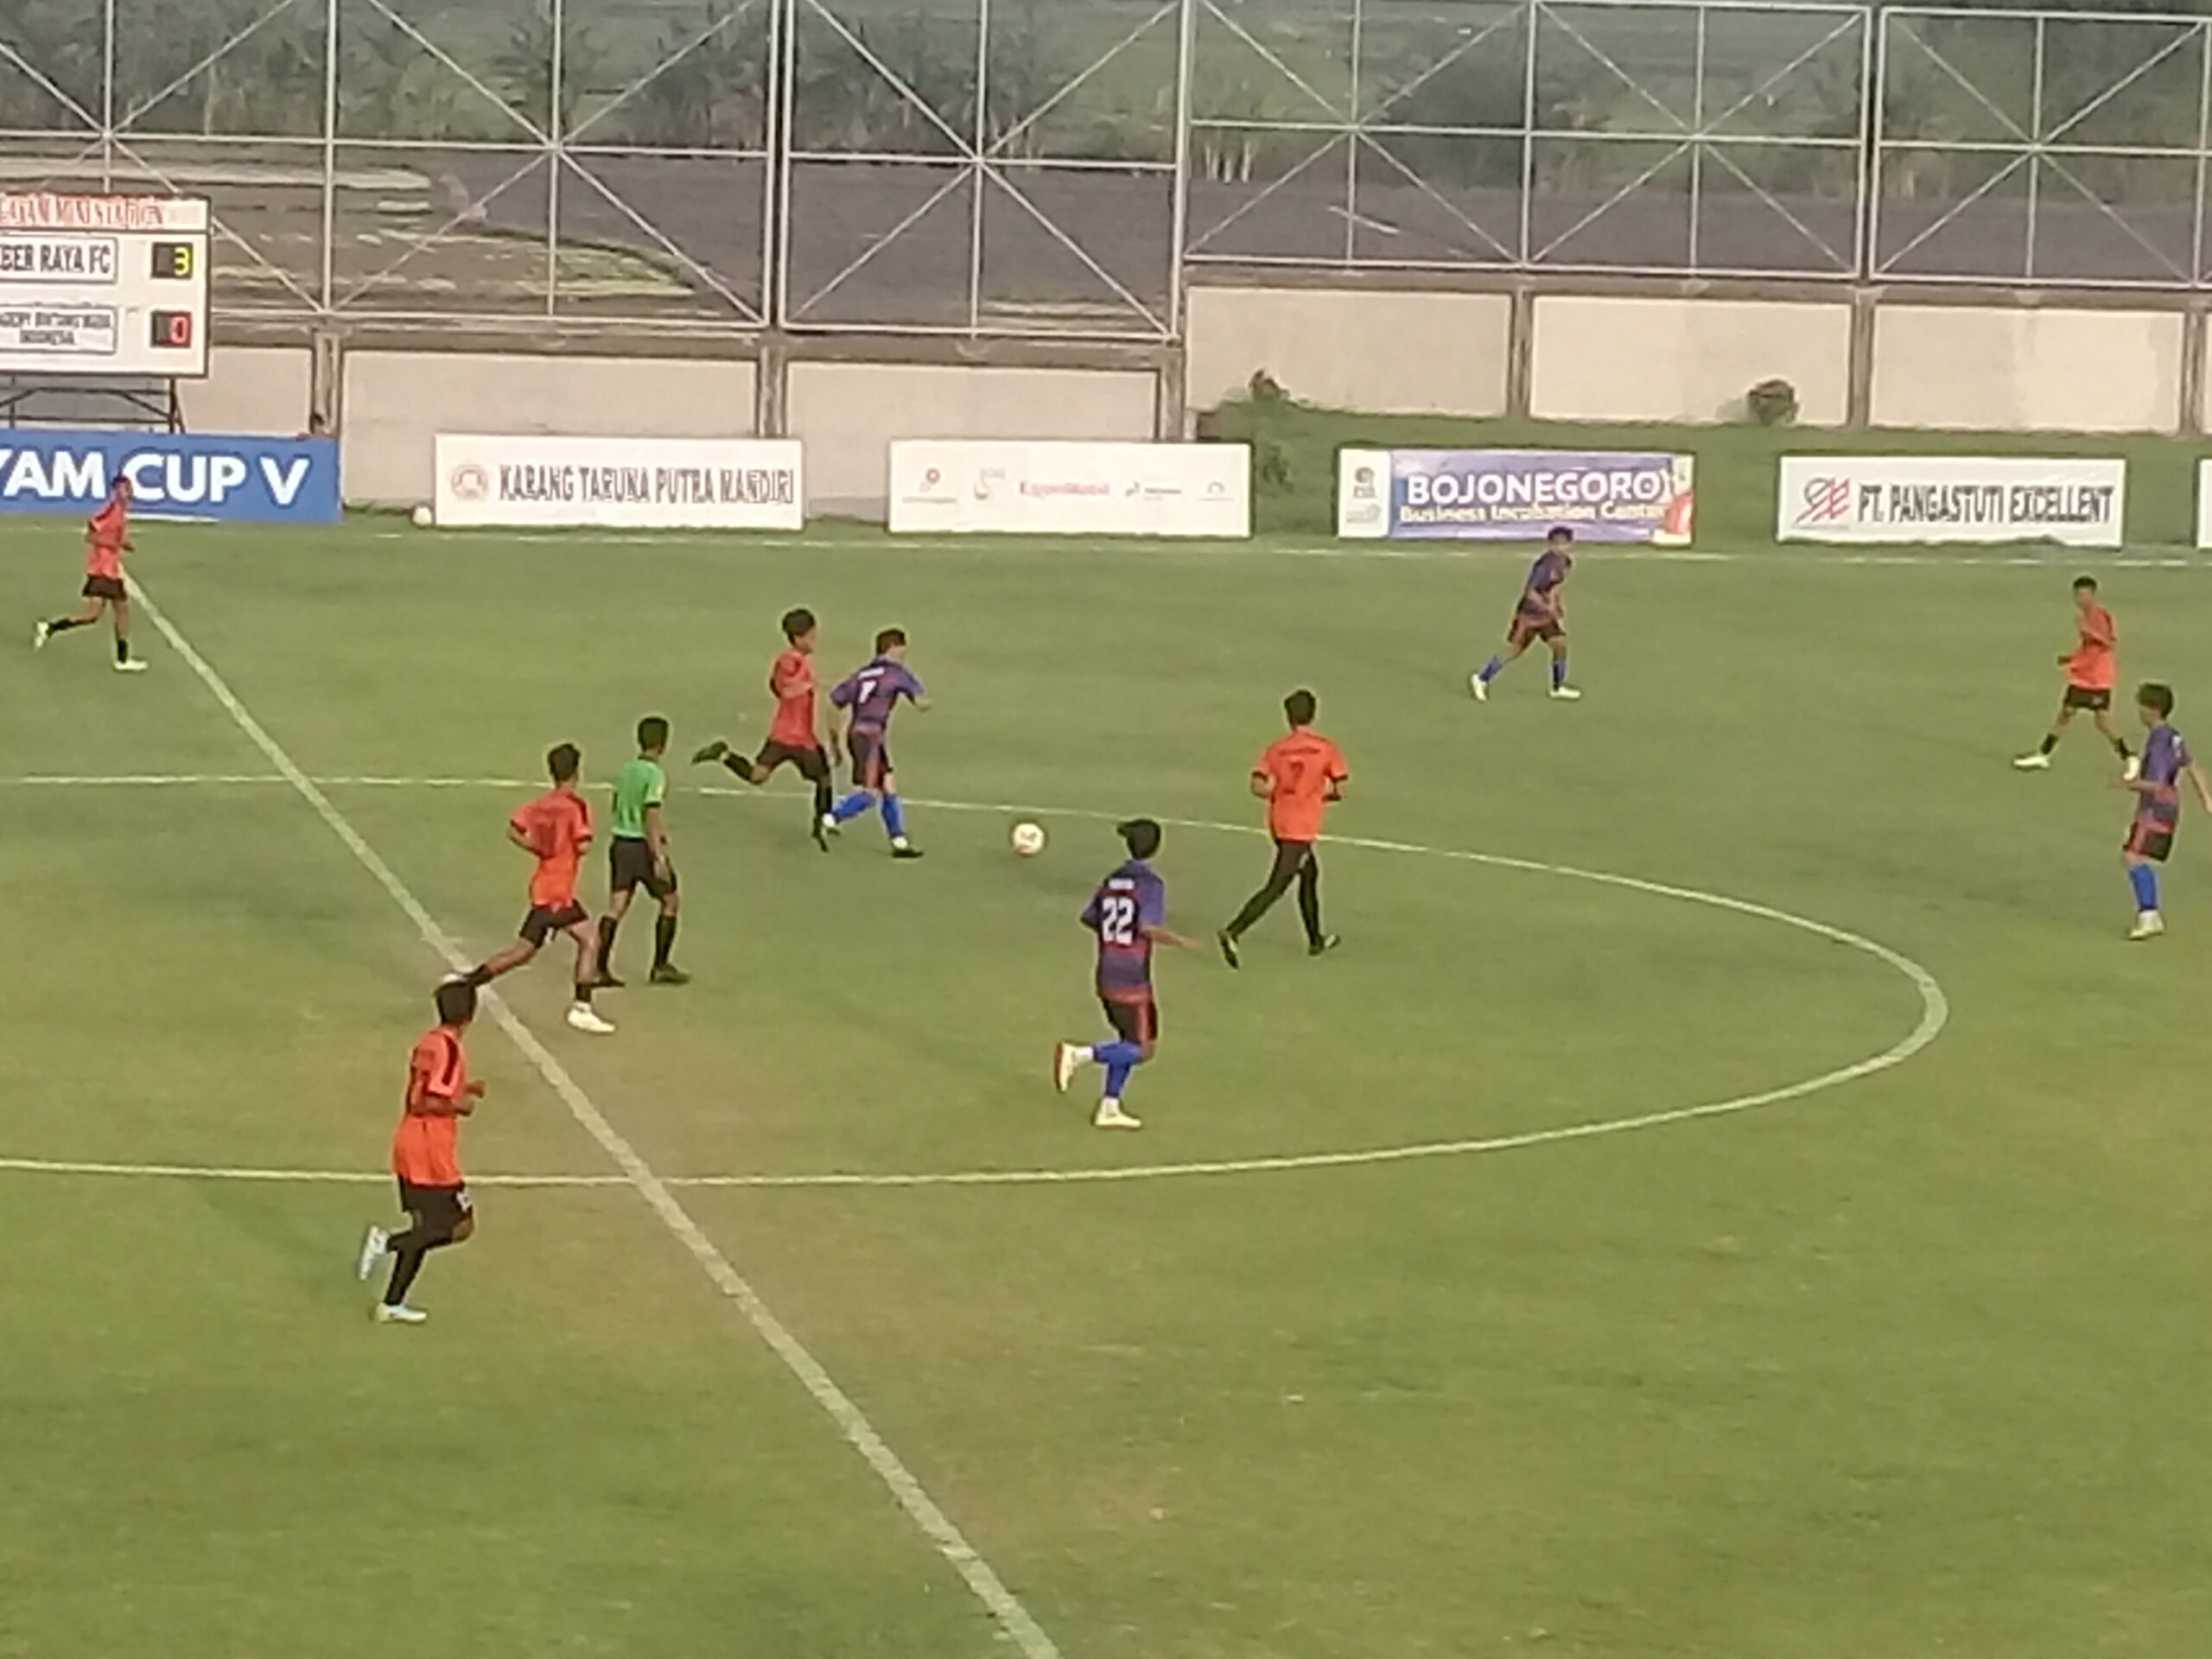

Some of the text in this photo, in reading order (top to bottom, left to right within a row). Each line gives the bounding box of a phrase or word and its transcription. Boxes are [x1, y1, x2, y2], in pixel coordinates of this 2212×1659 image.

[40, 245, 85, 272] RAYA
[89, 245, 111, 274] FC
[174, 246, 189, 276] 3
[170, 316, 188, 343] 0
[121, 454, 247, 503] CUP
[260, 456, 310, 505] V
[499, 464, 794, 505] KARANG TARUNA PUTRA MANDIRI
[1406, 471, 1663, 505] BOJONEGORO
[1858, 485, 2114, 523] PT. PANGASTUTI EXCELLENT
[1102, 895, 1135, 945] 22
